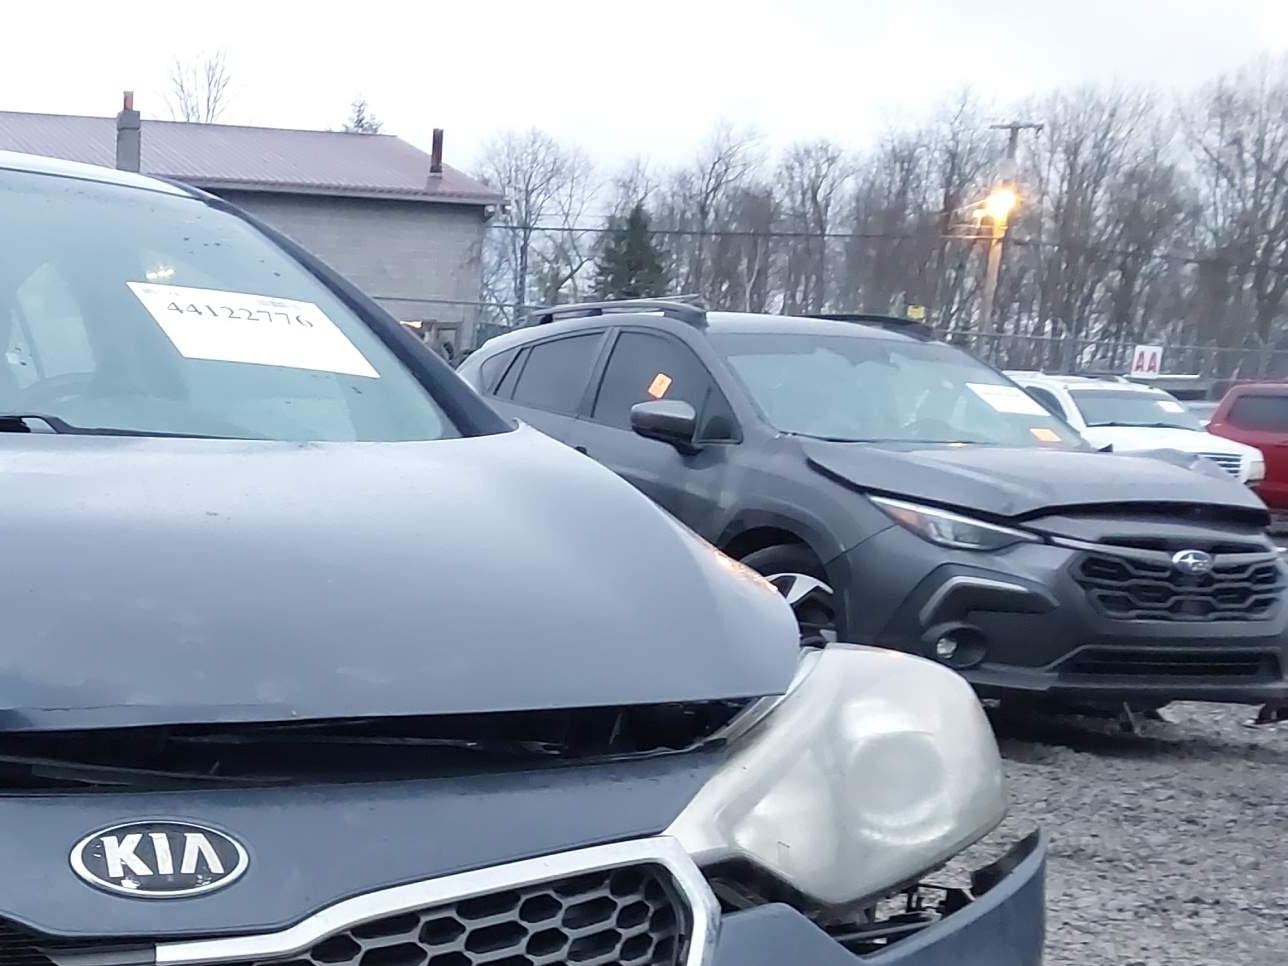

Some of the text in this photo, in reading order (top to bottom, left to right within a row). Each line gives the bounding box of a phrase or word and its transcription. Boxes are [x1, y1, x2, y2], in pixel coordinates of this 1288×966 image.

[167, 302, 314, 328] 44122776
[1134, 350, 1158, 373] AA
[99, 832, 225, 878] KIA
